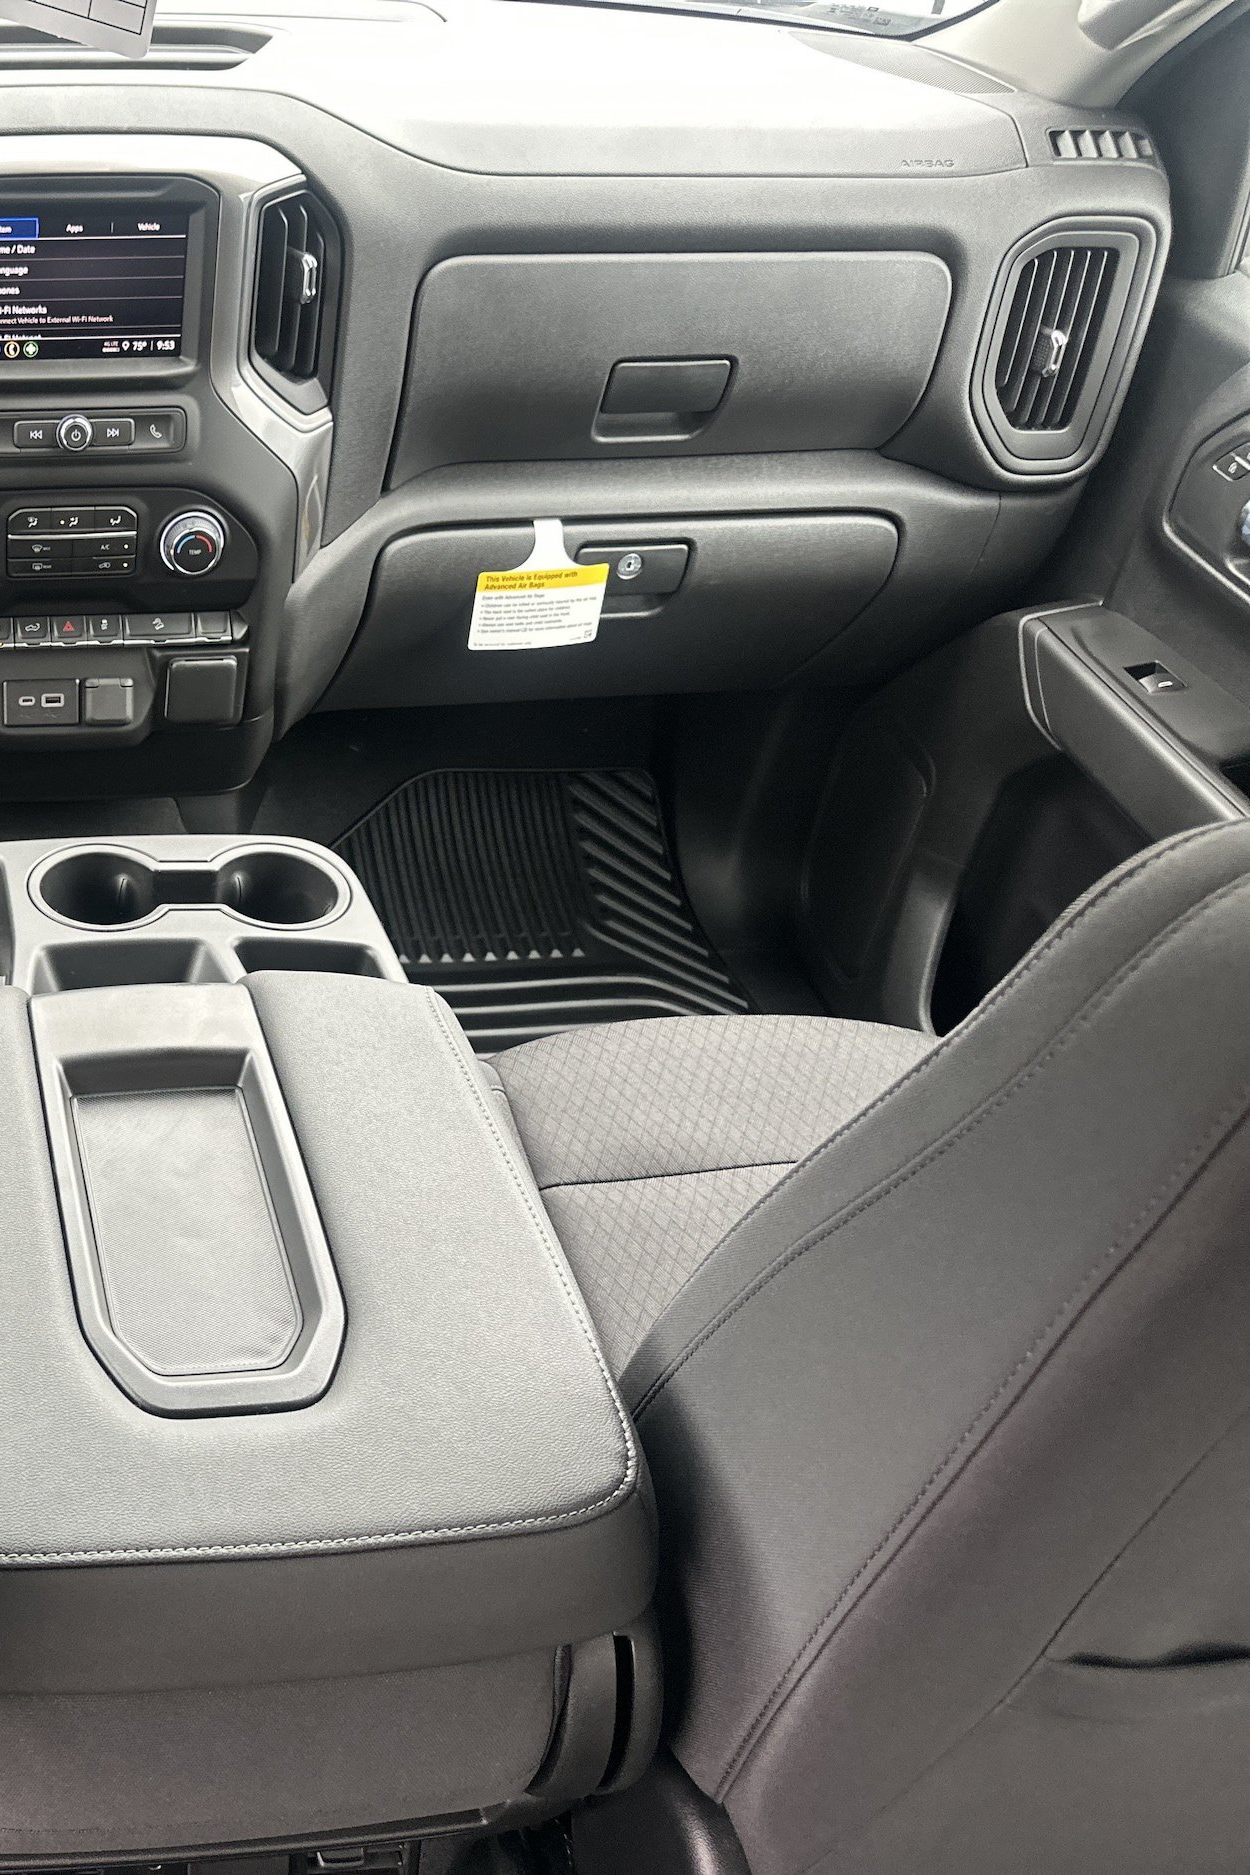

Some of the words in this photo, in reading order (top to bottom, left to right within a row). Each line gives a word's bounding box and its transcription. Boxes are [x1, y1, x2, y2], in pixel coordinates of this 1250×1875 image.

[901, 159, 955, 168] AIRBAG
[65, 224, 84, 233] Apps
[137, 222, 161, 231] Vehicle
[17, 244, 35, 254] Date
[12, 304, 48, 315] Networks
[17, 316, 38, 324] Vehicle
[39, 316, 47, 324] to
[47, 316, 71, 324] External
[72, 315, 88, 323] Wi-Fi
[156, 339, 175, 351] 9:53
[533, 572, 563, 581] Equipped
[484, 582, 516, 590] Advanced
[518, 581, 527, 589] Air
[529, 581, 545, 589] Bags
